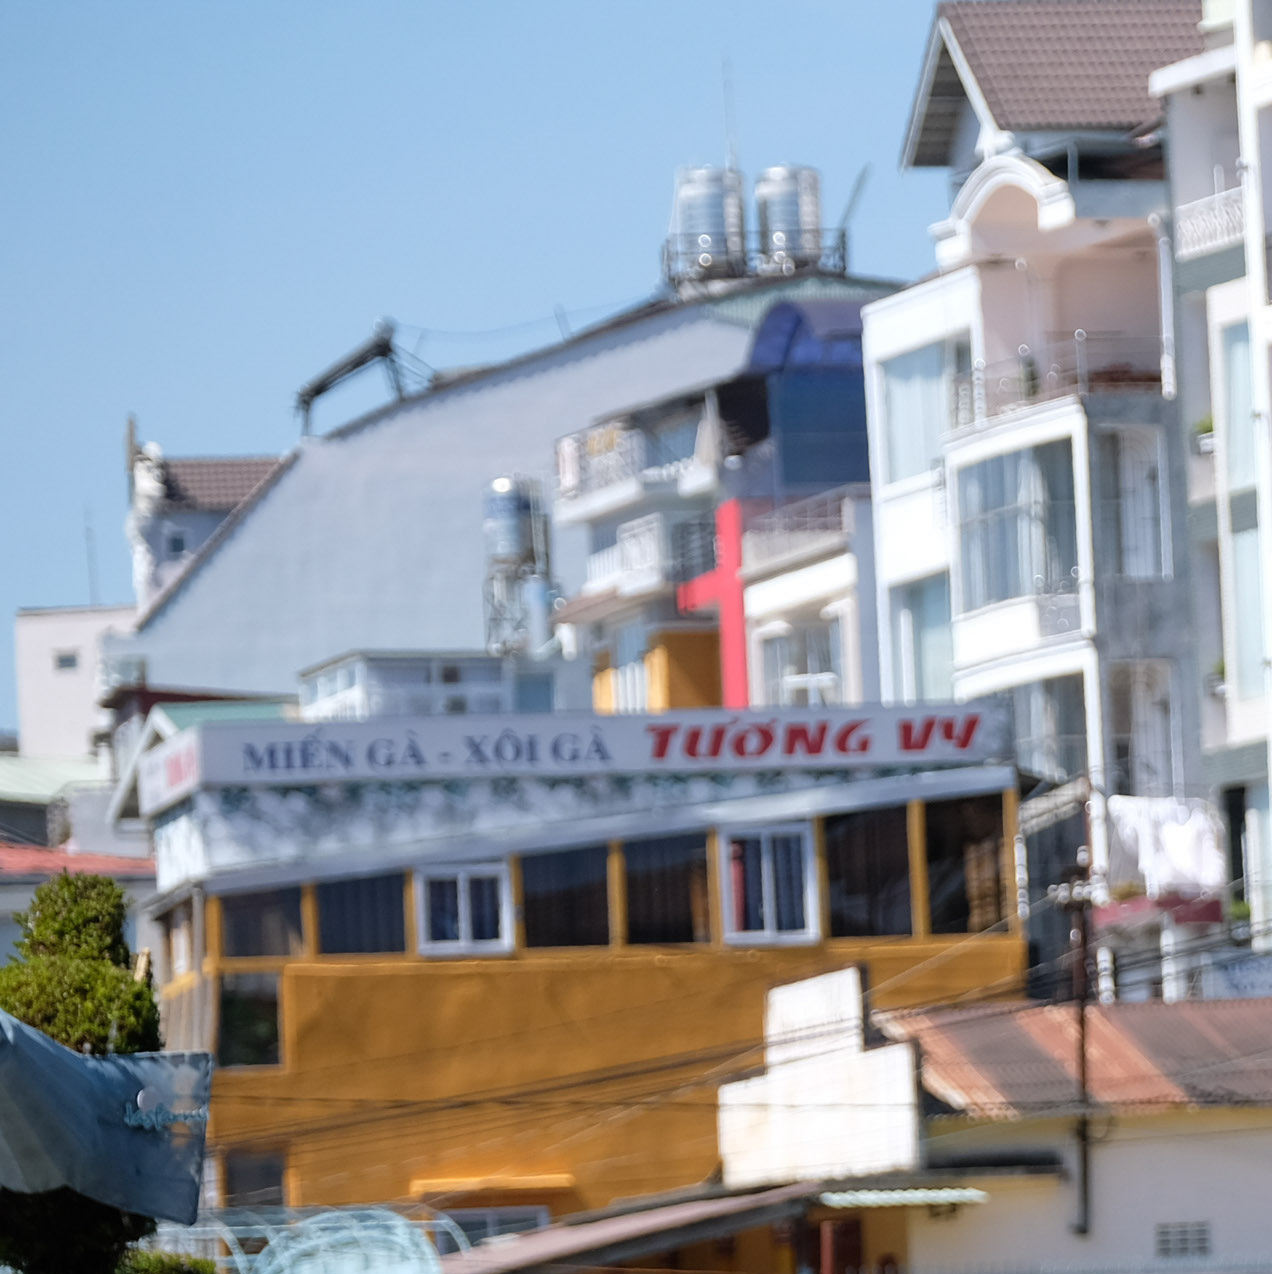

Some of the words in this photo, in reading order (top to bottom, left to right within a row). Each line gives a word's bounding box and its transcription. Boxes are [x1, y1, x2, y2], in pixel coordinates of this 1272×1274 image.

[365, 728, 428, 767] GÀ
[462, 727, 541, 764] XÔI
[549, 723, 613, 762] GÀ
[898, 713, 982, 752] VY
